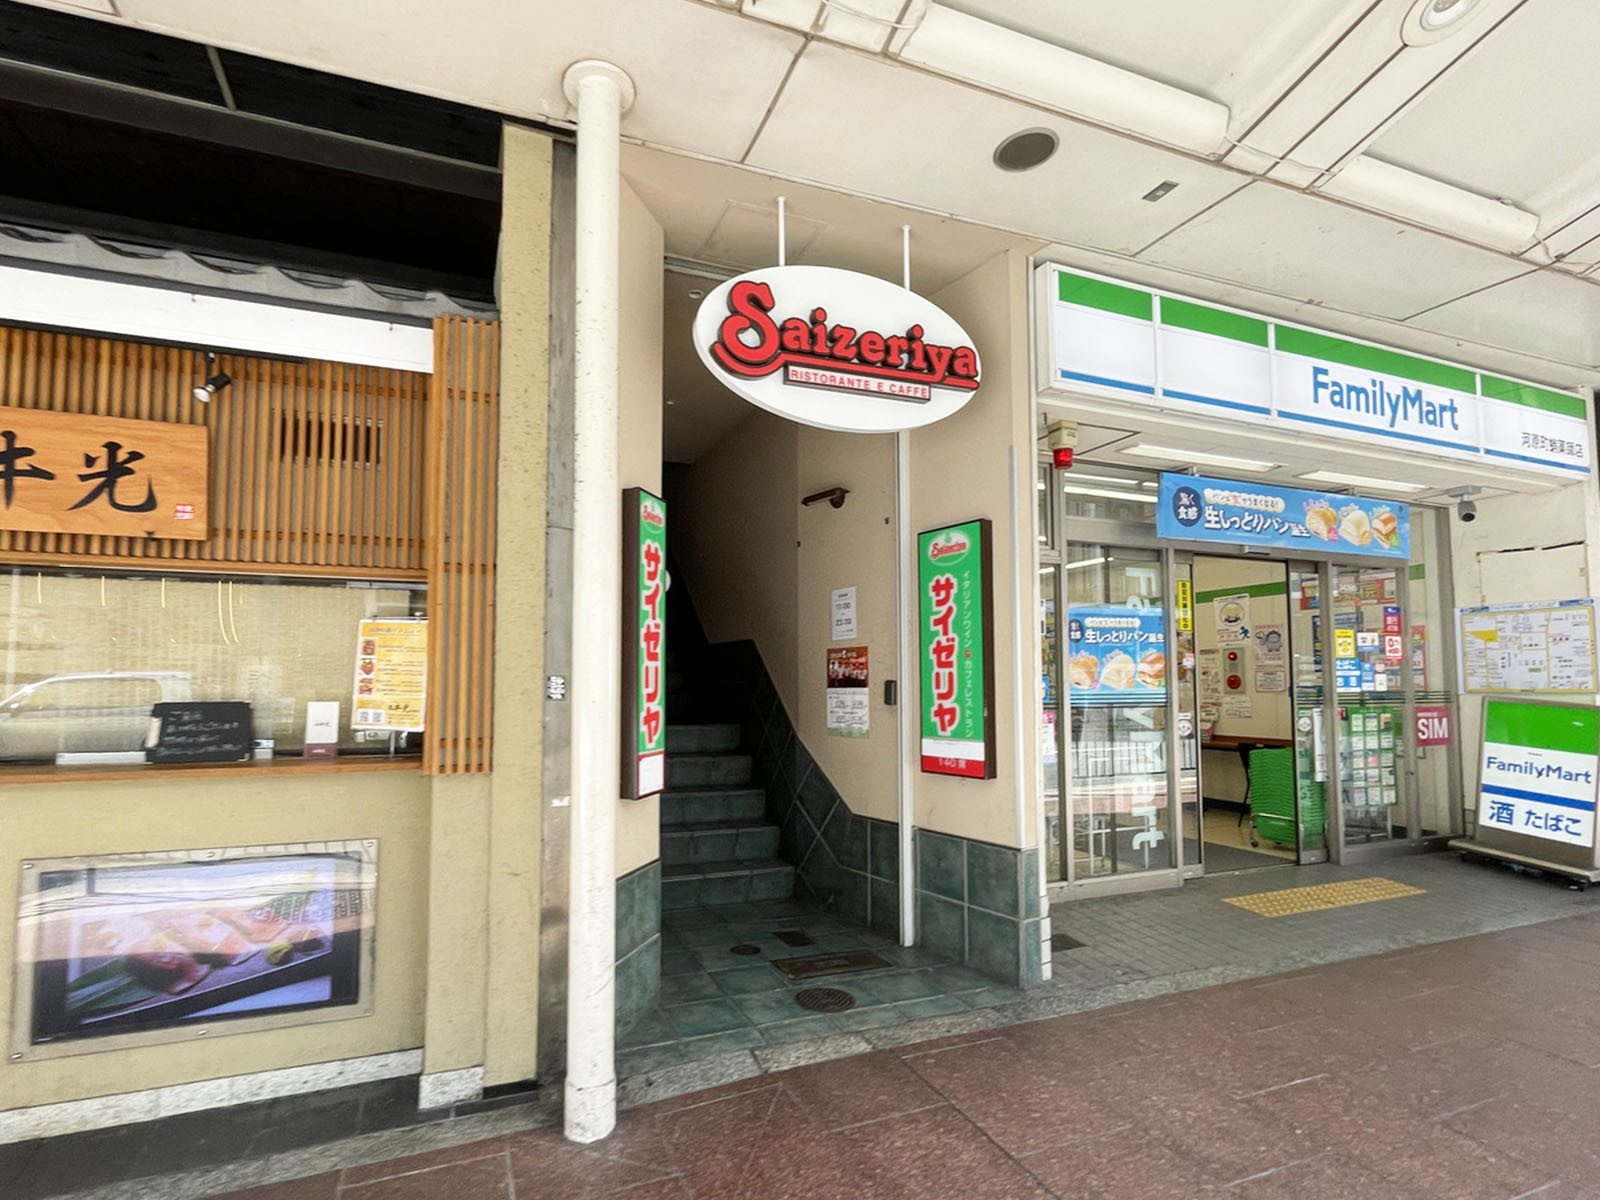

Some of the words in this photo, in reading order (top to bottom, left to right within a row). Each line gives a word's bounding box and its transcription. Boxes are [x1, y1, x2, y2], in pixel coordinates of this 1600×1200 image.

[711, 280, 980, 390] Saizeriya
[790, 369, 871, 391] RISTORANTE
[877, 382, 886, 393] E
[1312, 366, 1459, 432] FamilyMart
[641, 538, 663, 748] サイゼリヤ
[929, 574, 960, 737] サイゼリヤ
[1418, 717, 1448, 740] SIM
[1486, 756, 1592, 784] FamilyMart
[1489, 800, 1515, 825] 酒
[1525, 809, 1582, 836] たばこ
